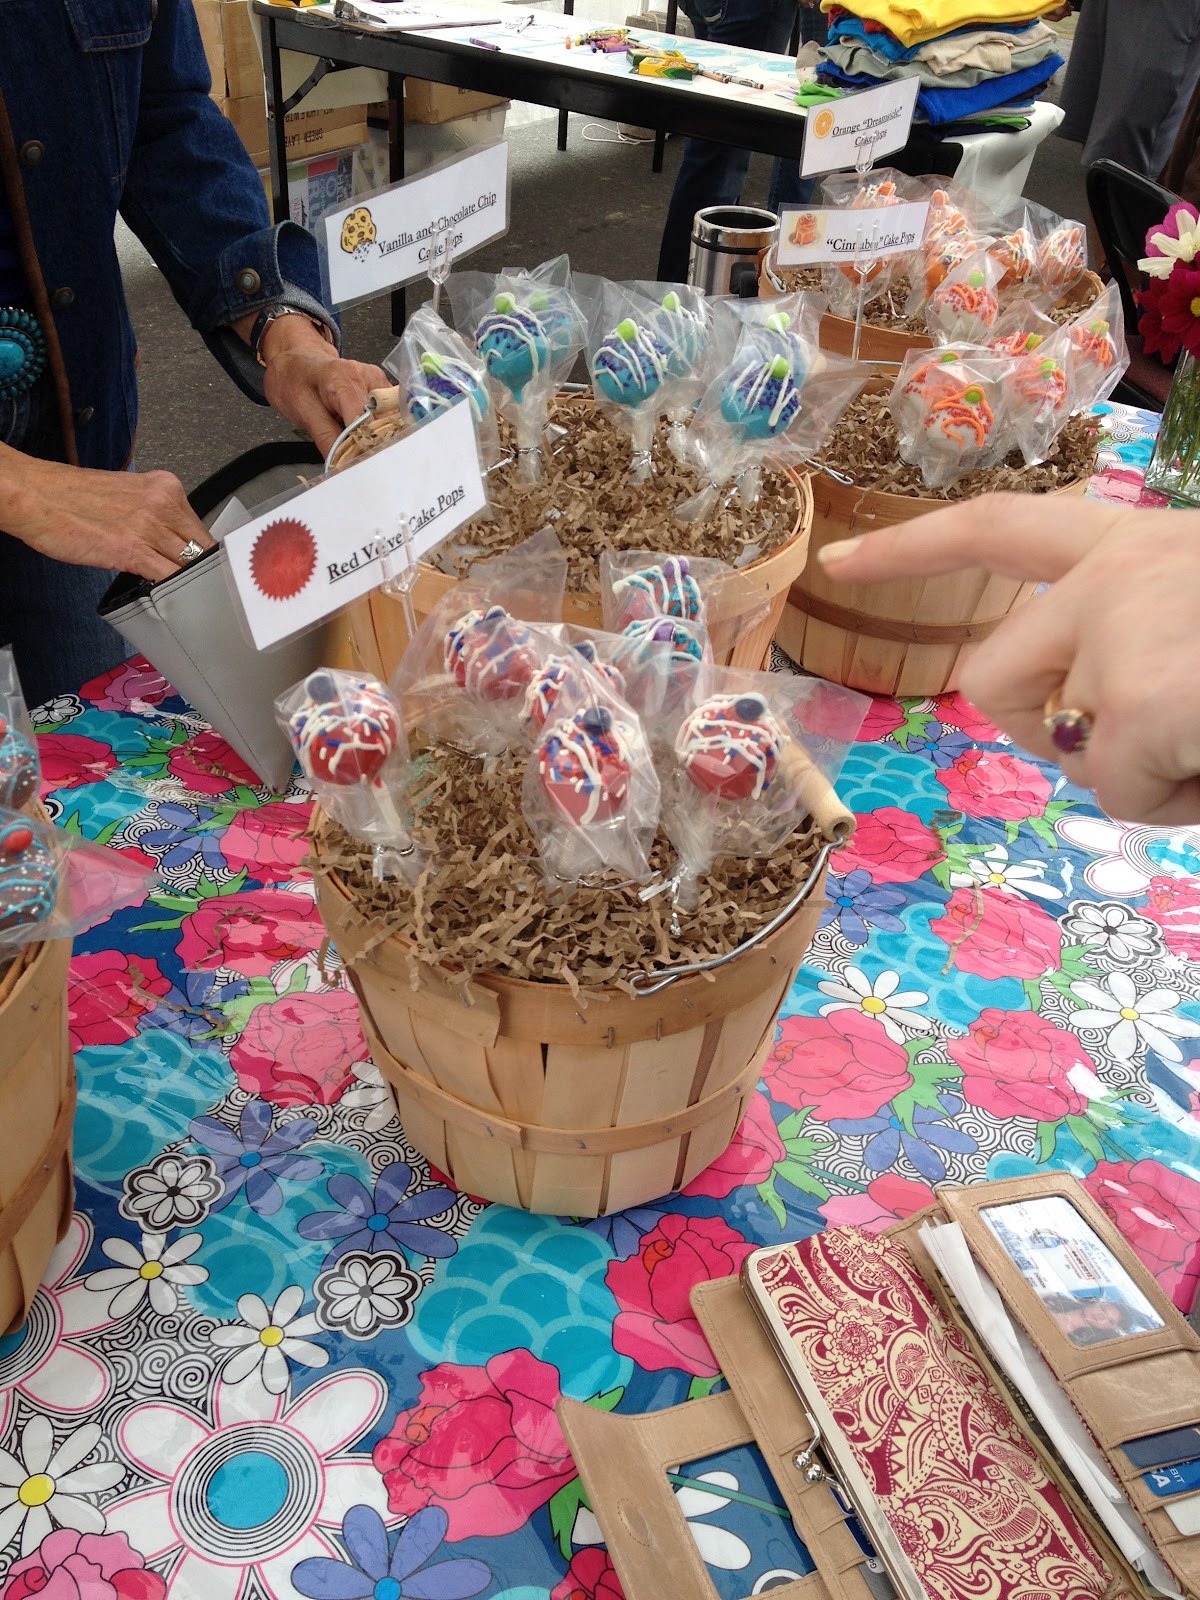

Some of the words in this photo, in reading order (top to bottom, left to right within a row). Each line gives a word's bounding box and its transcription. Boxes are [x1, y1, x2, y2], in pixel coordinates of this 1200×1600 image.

[832, 124, 861, 137] Orange
[378, 231, 413, 255] Vanilla
[415, 221, 434, 240] and
[437, 203, 476, 231] Chocolate
[477, 192, 498, 209] Chip
[445, 232, 463, 250] ps
[883, 233, 899, 247] Cake
[900, 231, 916, 245] Pops
[326, 551, 359, 581] Red
[361, 532, 406, 560] Veve
[408, 507, 436, 533] Cake
[437, 485, 465, 512] Pops
[1168, 1465, 1185, 1483] BIT
